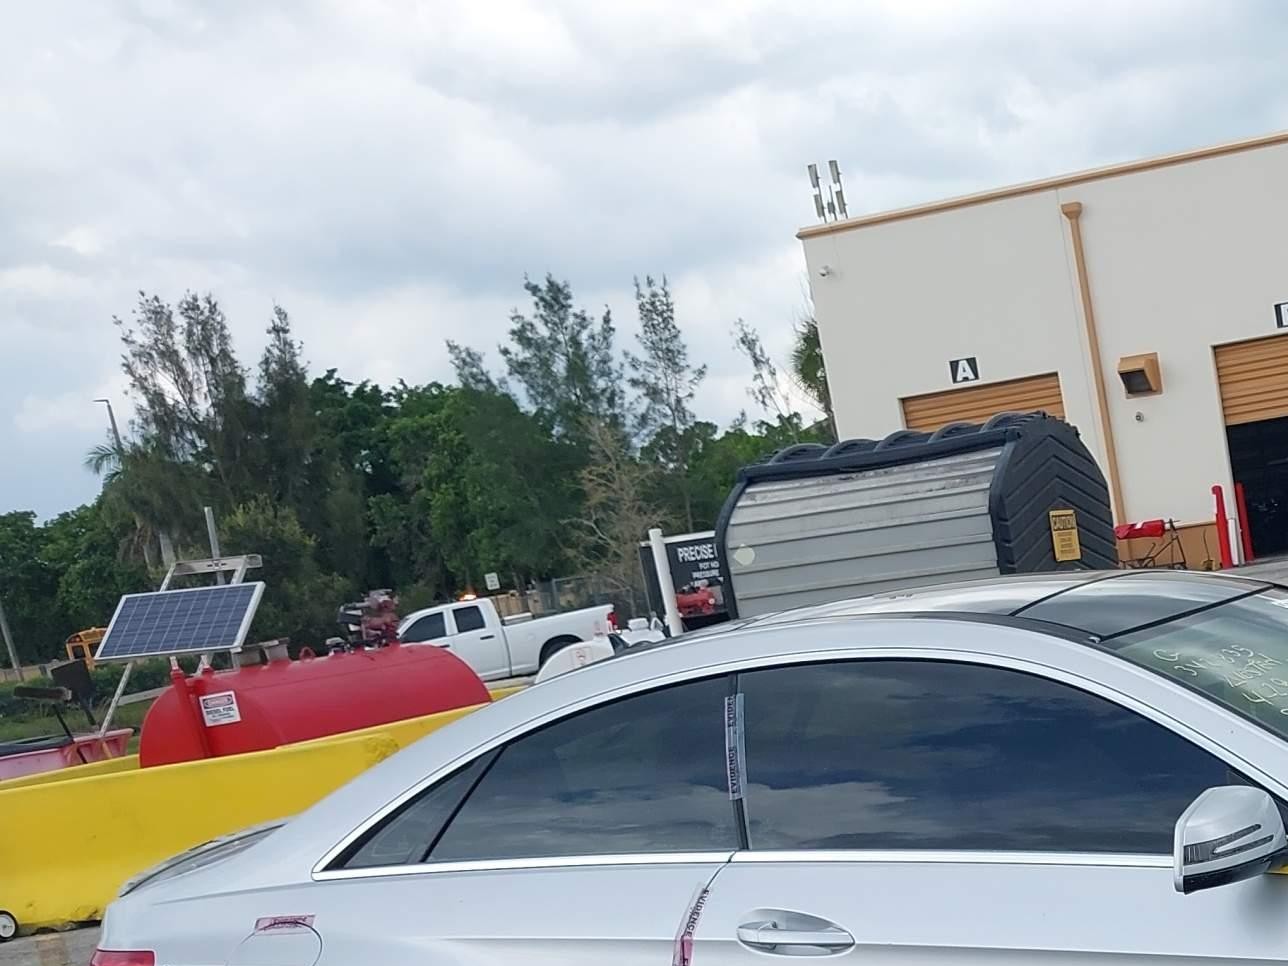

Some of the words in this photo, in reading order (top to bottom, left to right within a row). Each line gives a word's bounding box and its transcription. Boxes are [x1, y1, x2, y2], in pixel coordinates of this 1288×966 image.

[956, 359, 976, 382] A
[677, 544, 714, 562] PRECISE
[728, 747, 738, 793] EVIDENCE
[686, 889, 710, 938] EVIDENCE
